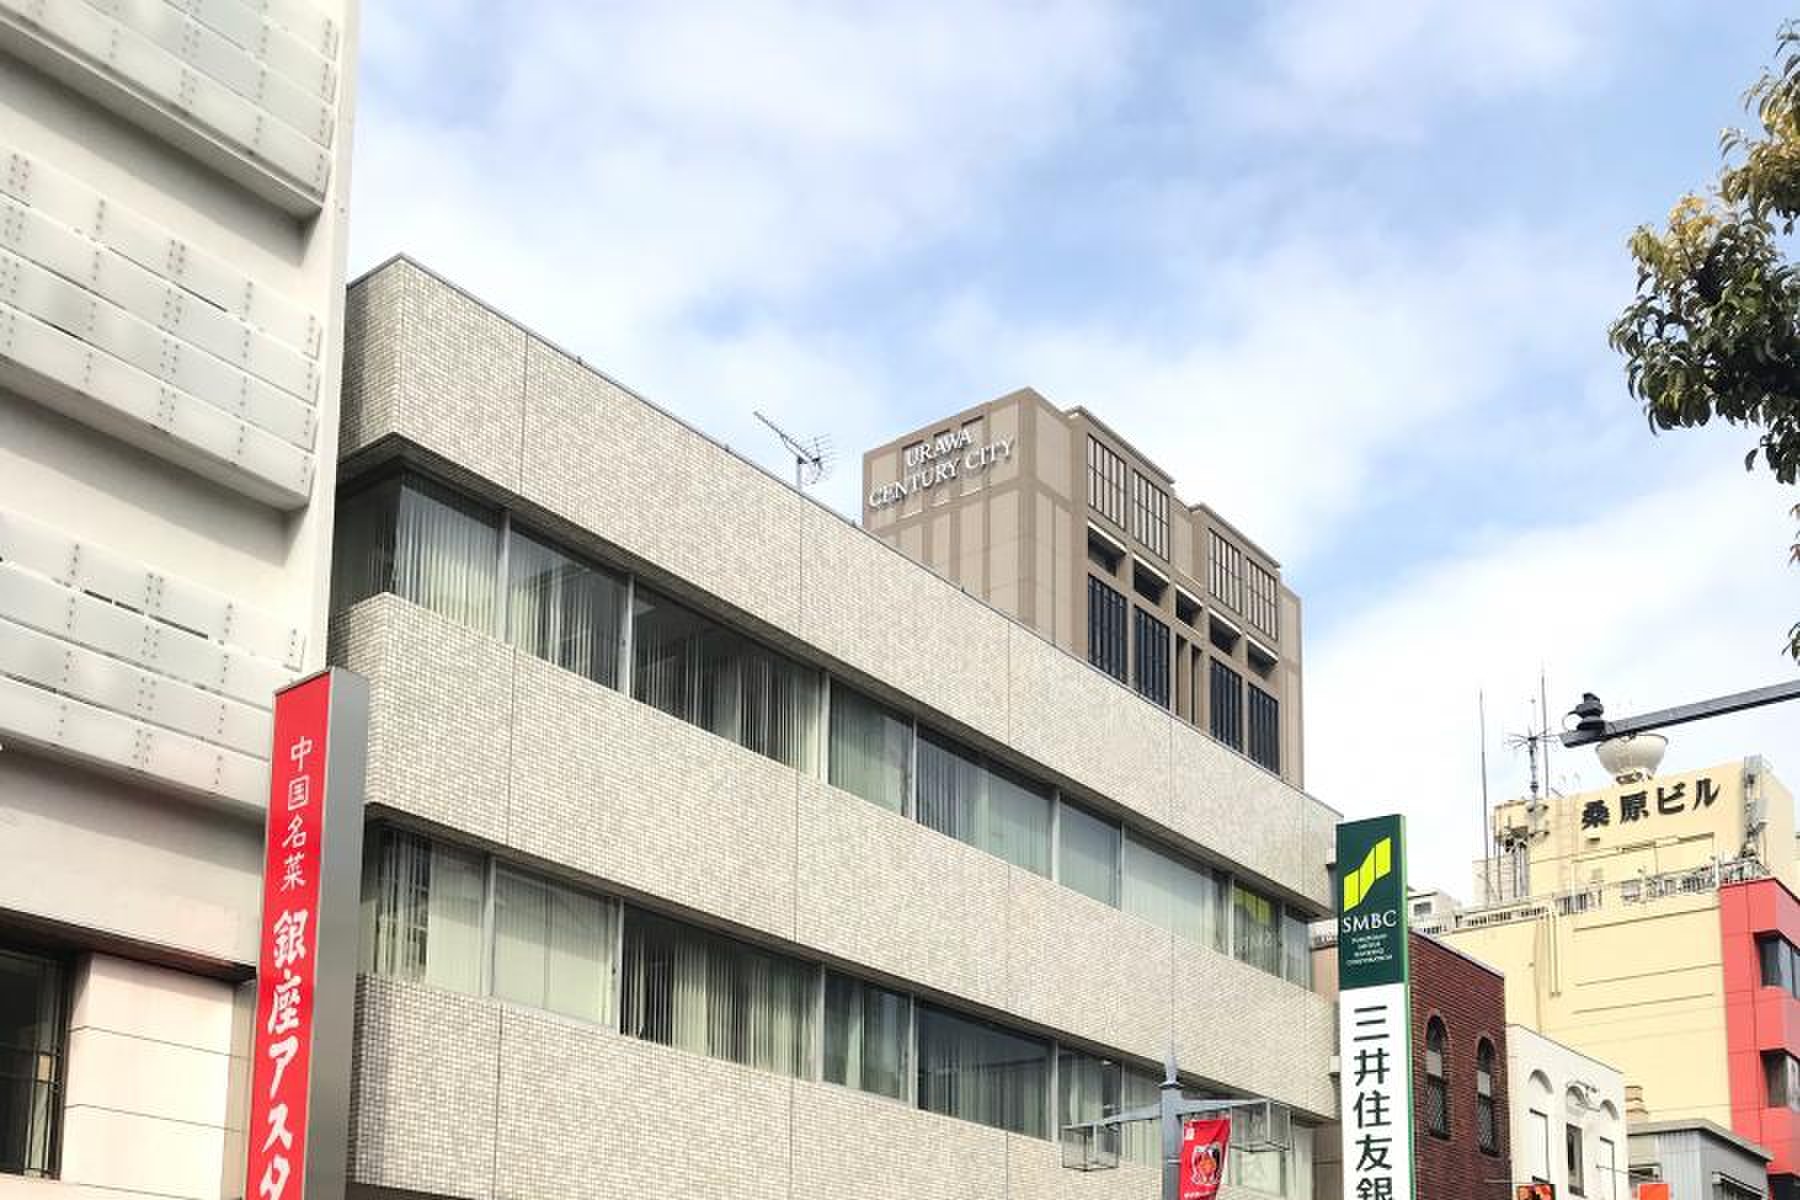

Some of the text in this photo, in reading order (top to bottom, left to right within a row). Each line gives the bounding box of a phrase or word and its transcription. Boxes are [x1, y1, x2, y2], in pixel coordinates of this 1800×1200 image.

[869, 433, 1016, 510] CENTURY CITY
[907, 428, 973, 467] URAWA
[280, 734, 314, 892] 中国名菜
[1581, 776, 1722, 831] 桑原ビル
[1342, 909, 1398, 934] SMBC
